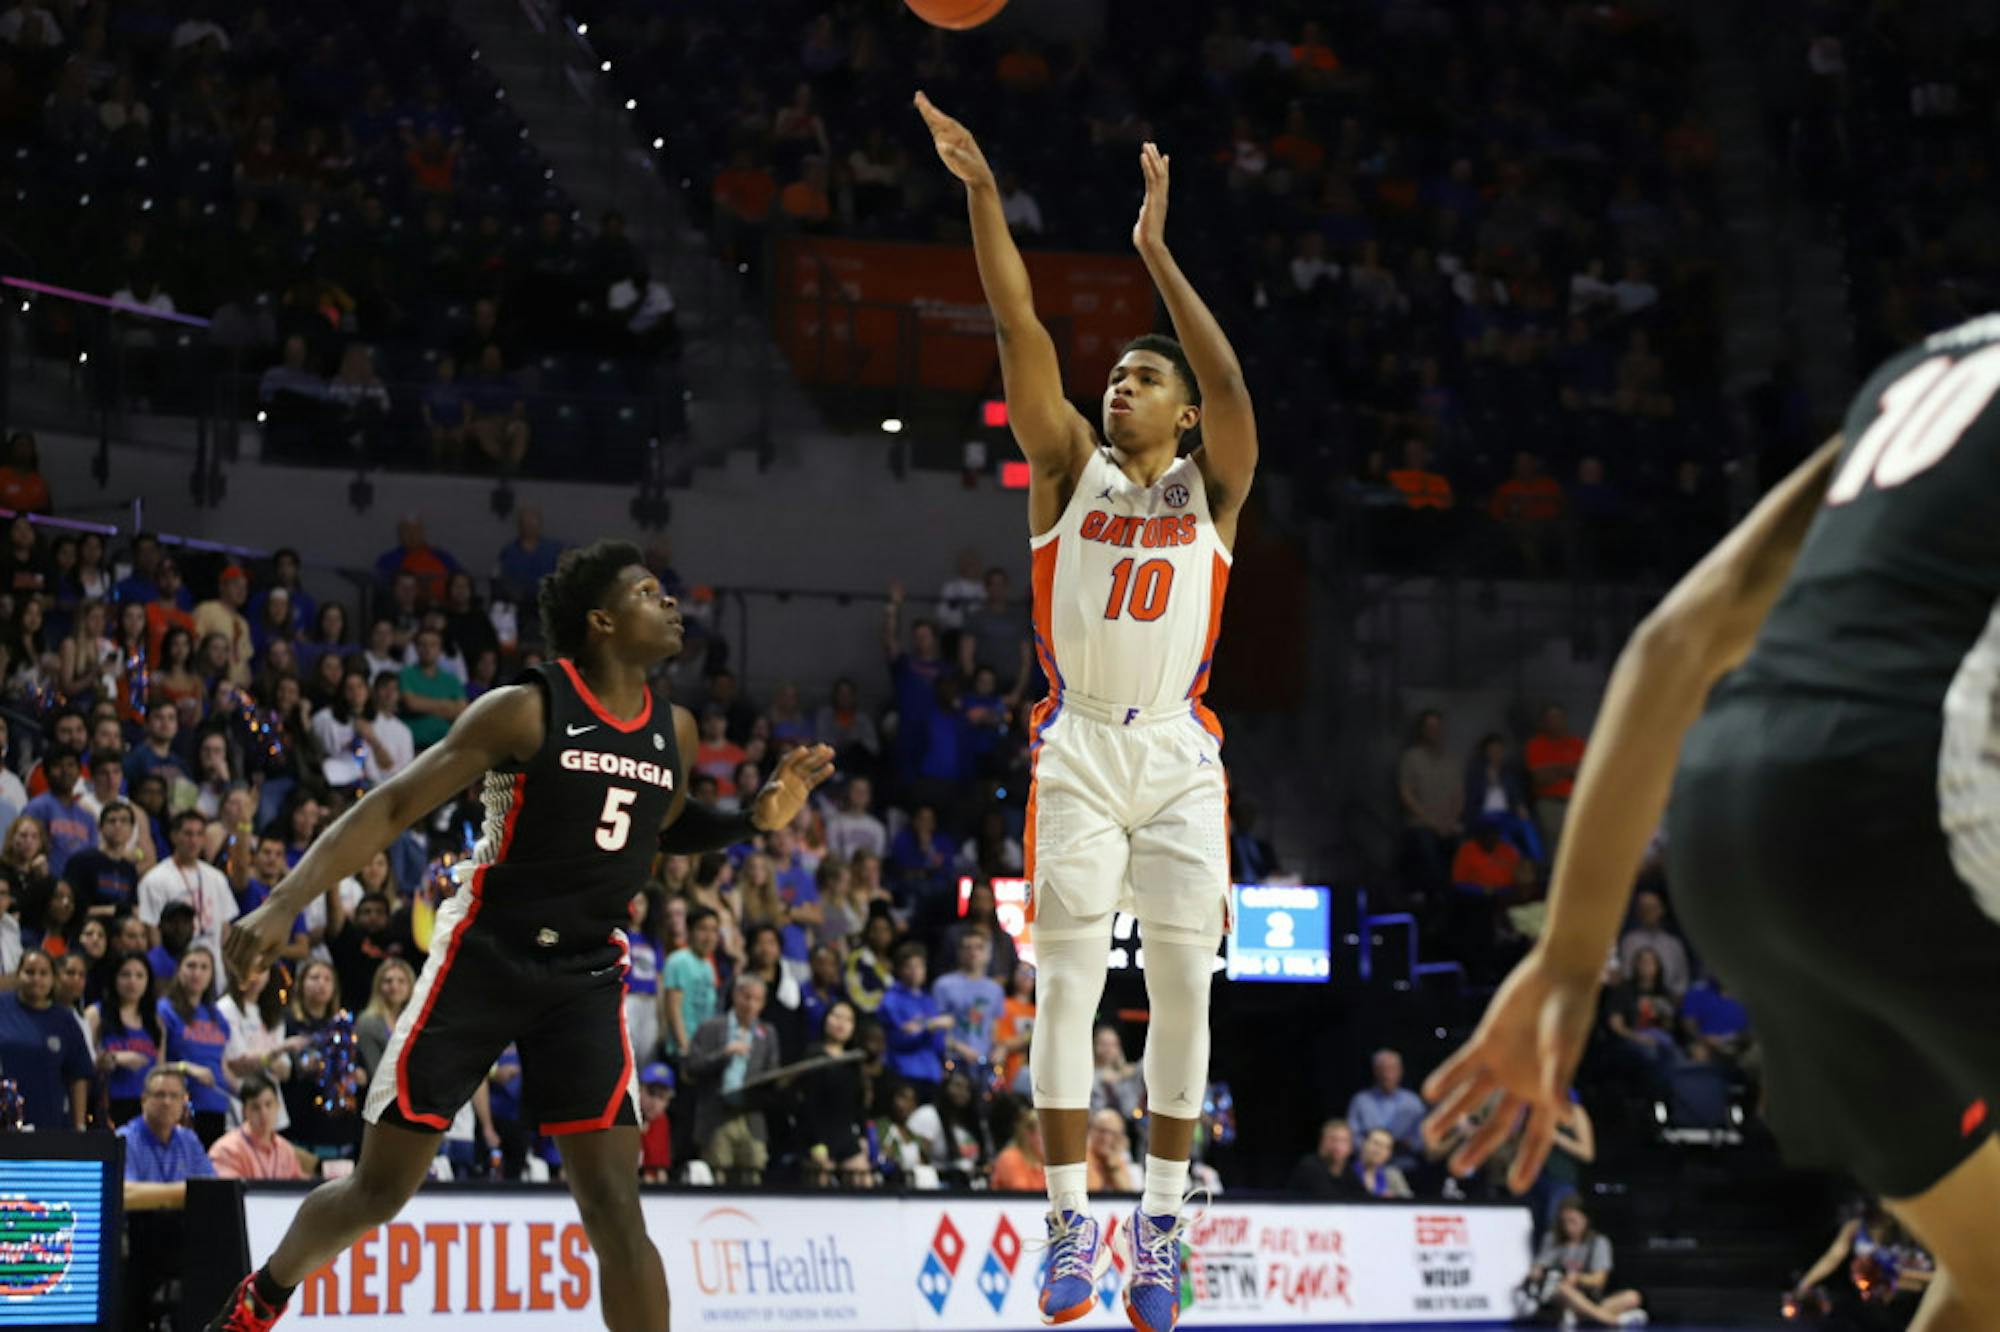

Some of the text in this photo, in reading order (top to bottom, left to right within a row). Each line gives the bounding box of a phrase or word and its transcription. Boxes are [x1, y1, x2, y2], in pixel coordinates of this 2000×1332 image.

[1827, 340, 2000, 506] 10
[1080, 510, 1197, 548] GATORS
[1104, 558, 1174, 622] 10
[1123, 708, 1140, 725] F
[560, 749, 674, 791] GEORGIA
[595, 786, 638, 851] 5
[1265, 911, 1294, 947] 2
